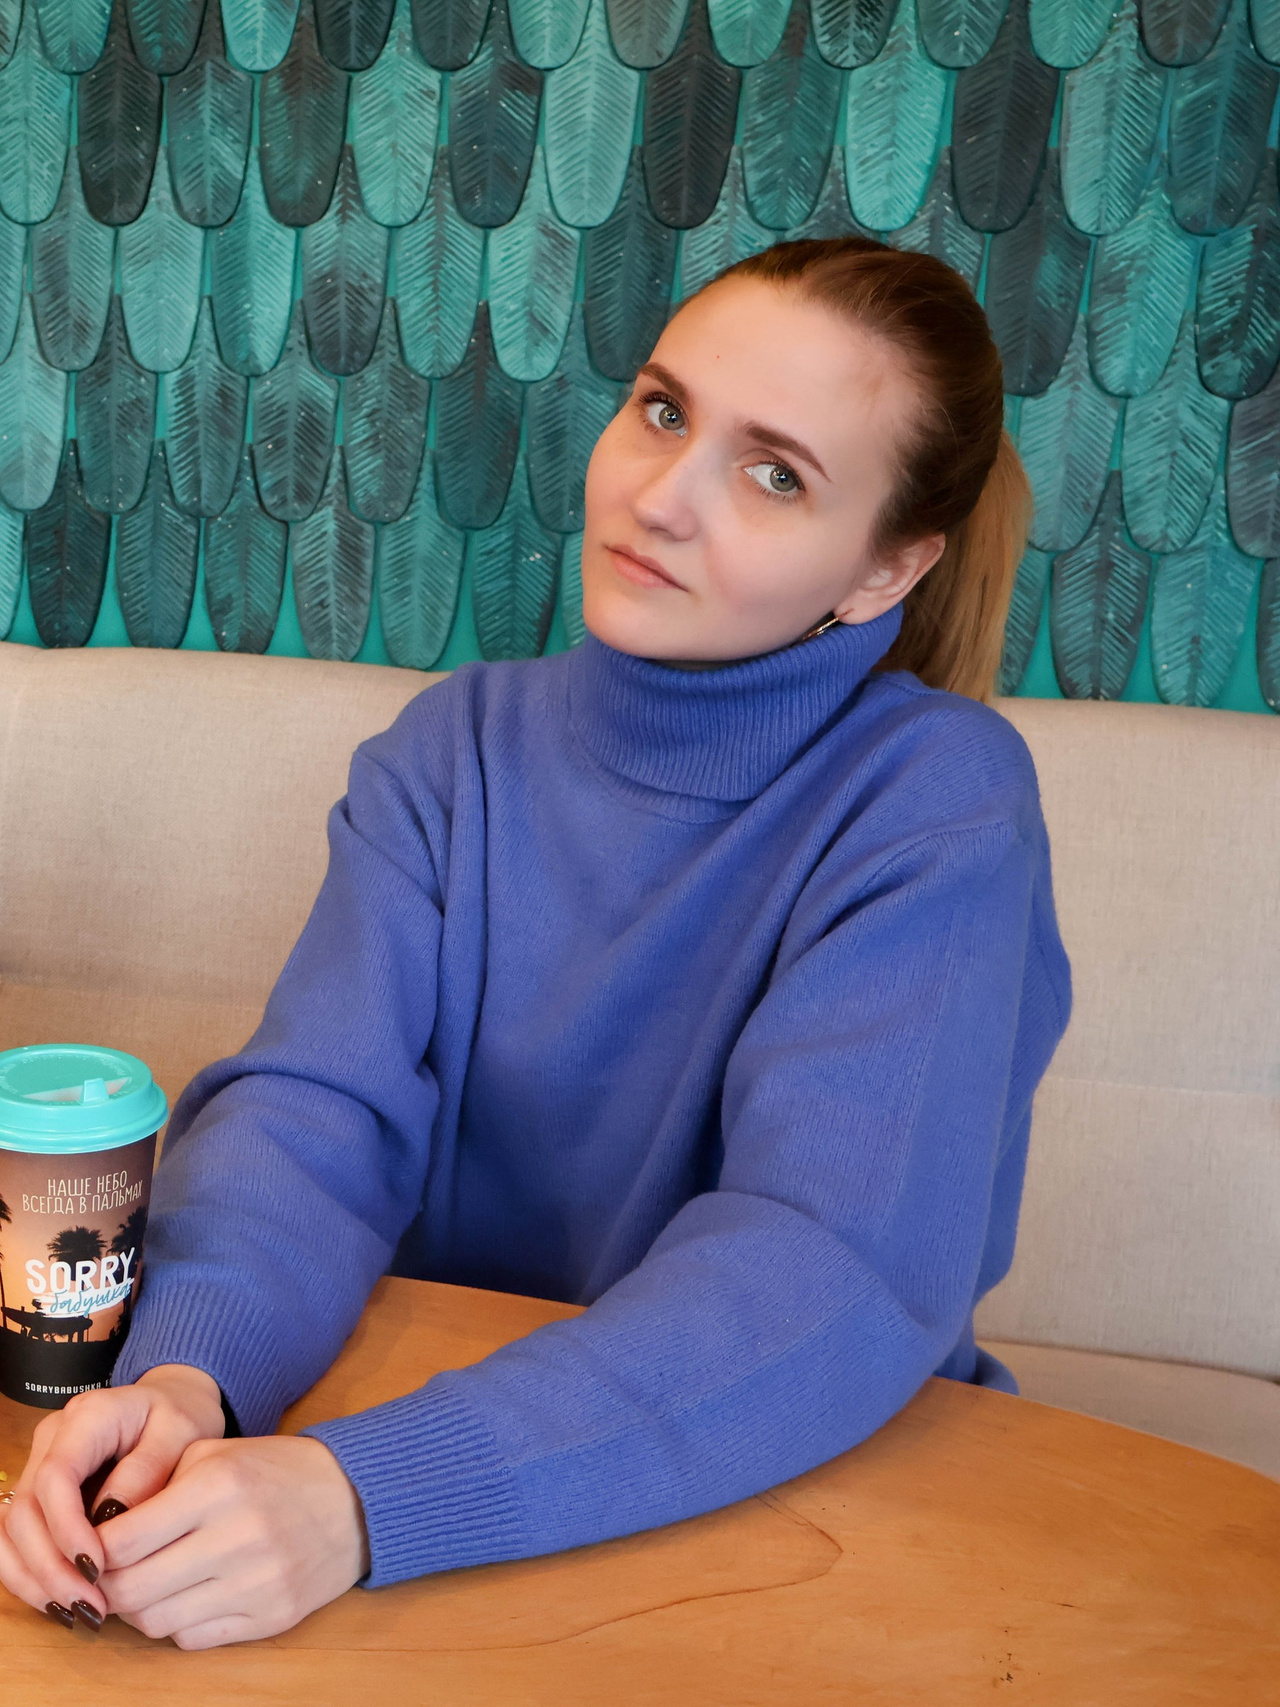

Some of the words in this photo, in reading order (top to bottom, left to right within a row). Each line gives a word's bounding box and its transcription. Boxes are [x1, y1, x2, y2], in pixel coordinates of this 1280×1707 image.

[22, 1193, 74, 1215] ВСЕГДА
[79, 1195, 87, 1214] В
[91, 1179, 143, 1213] ПАЛЬМАХ
[47, 1177, 92, 1197] НАШЕ
[96, 1170, 128, 1194] НЕБО
[25, 1247, 135, 1295] SORRY
[50, 1282, 131, 1317] бабушка
[24, 1381, 102, 1395] SORRYBABUSHKA
